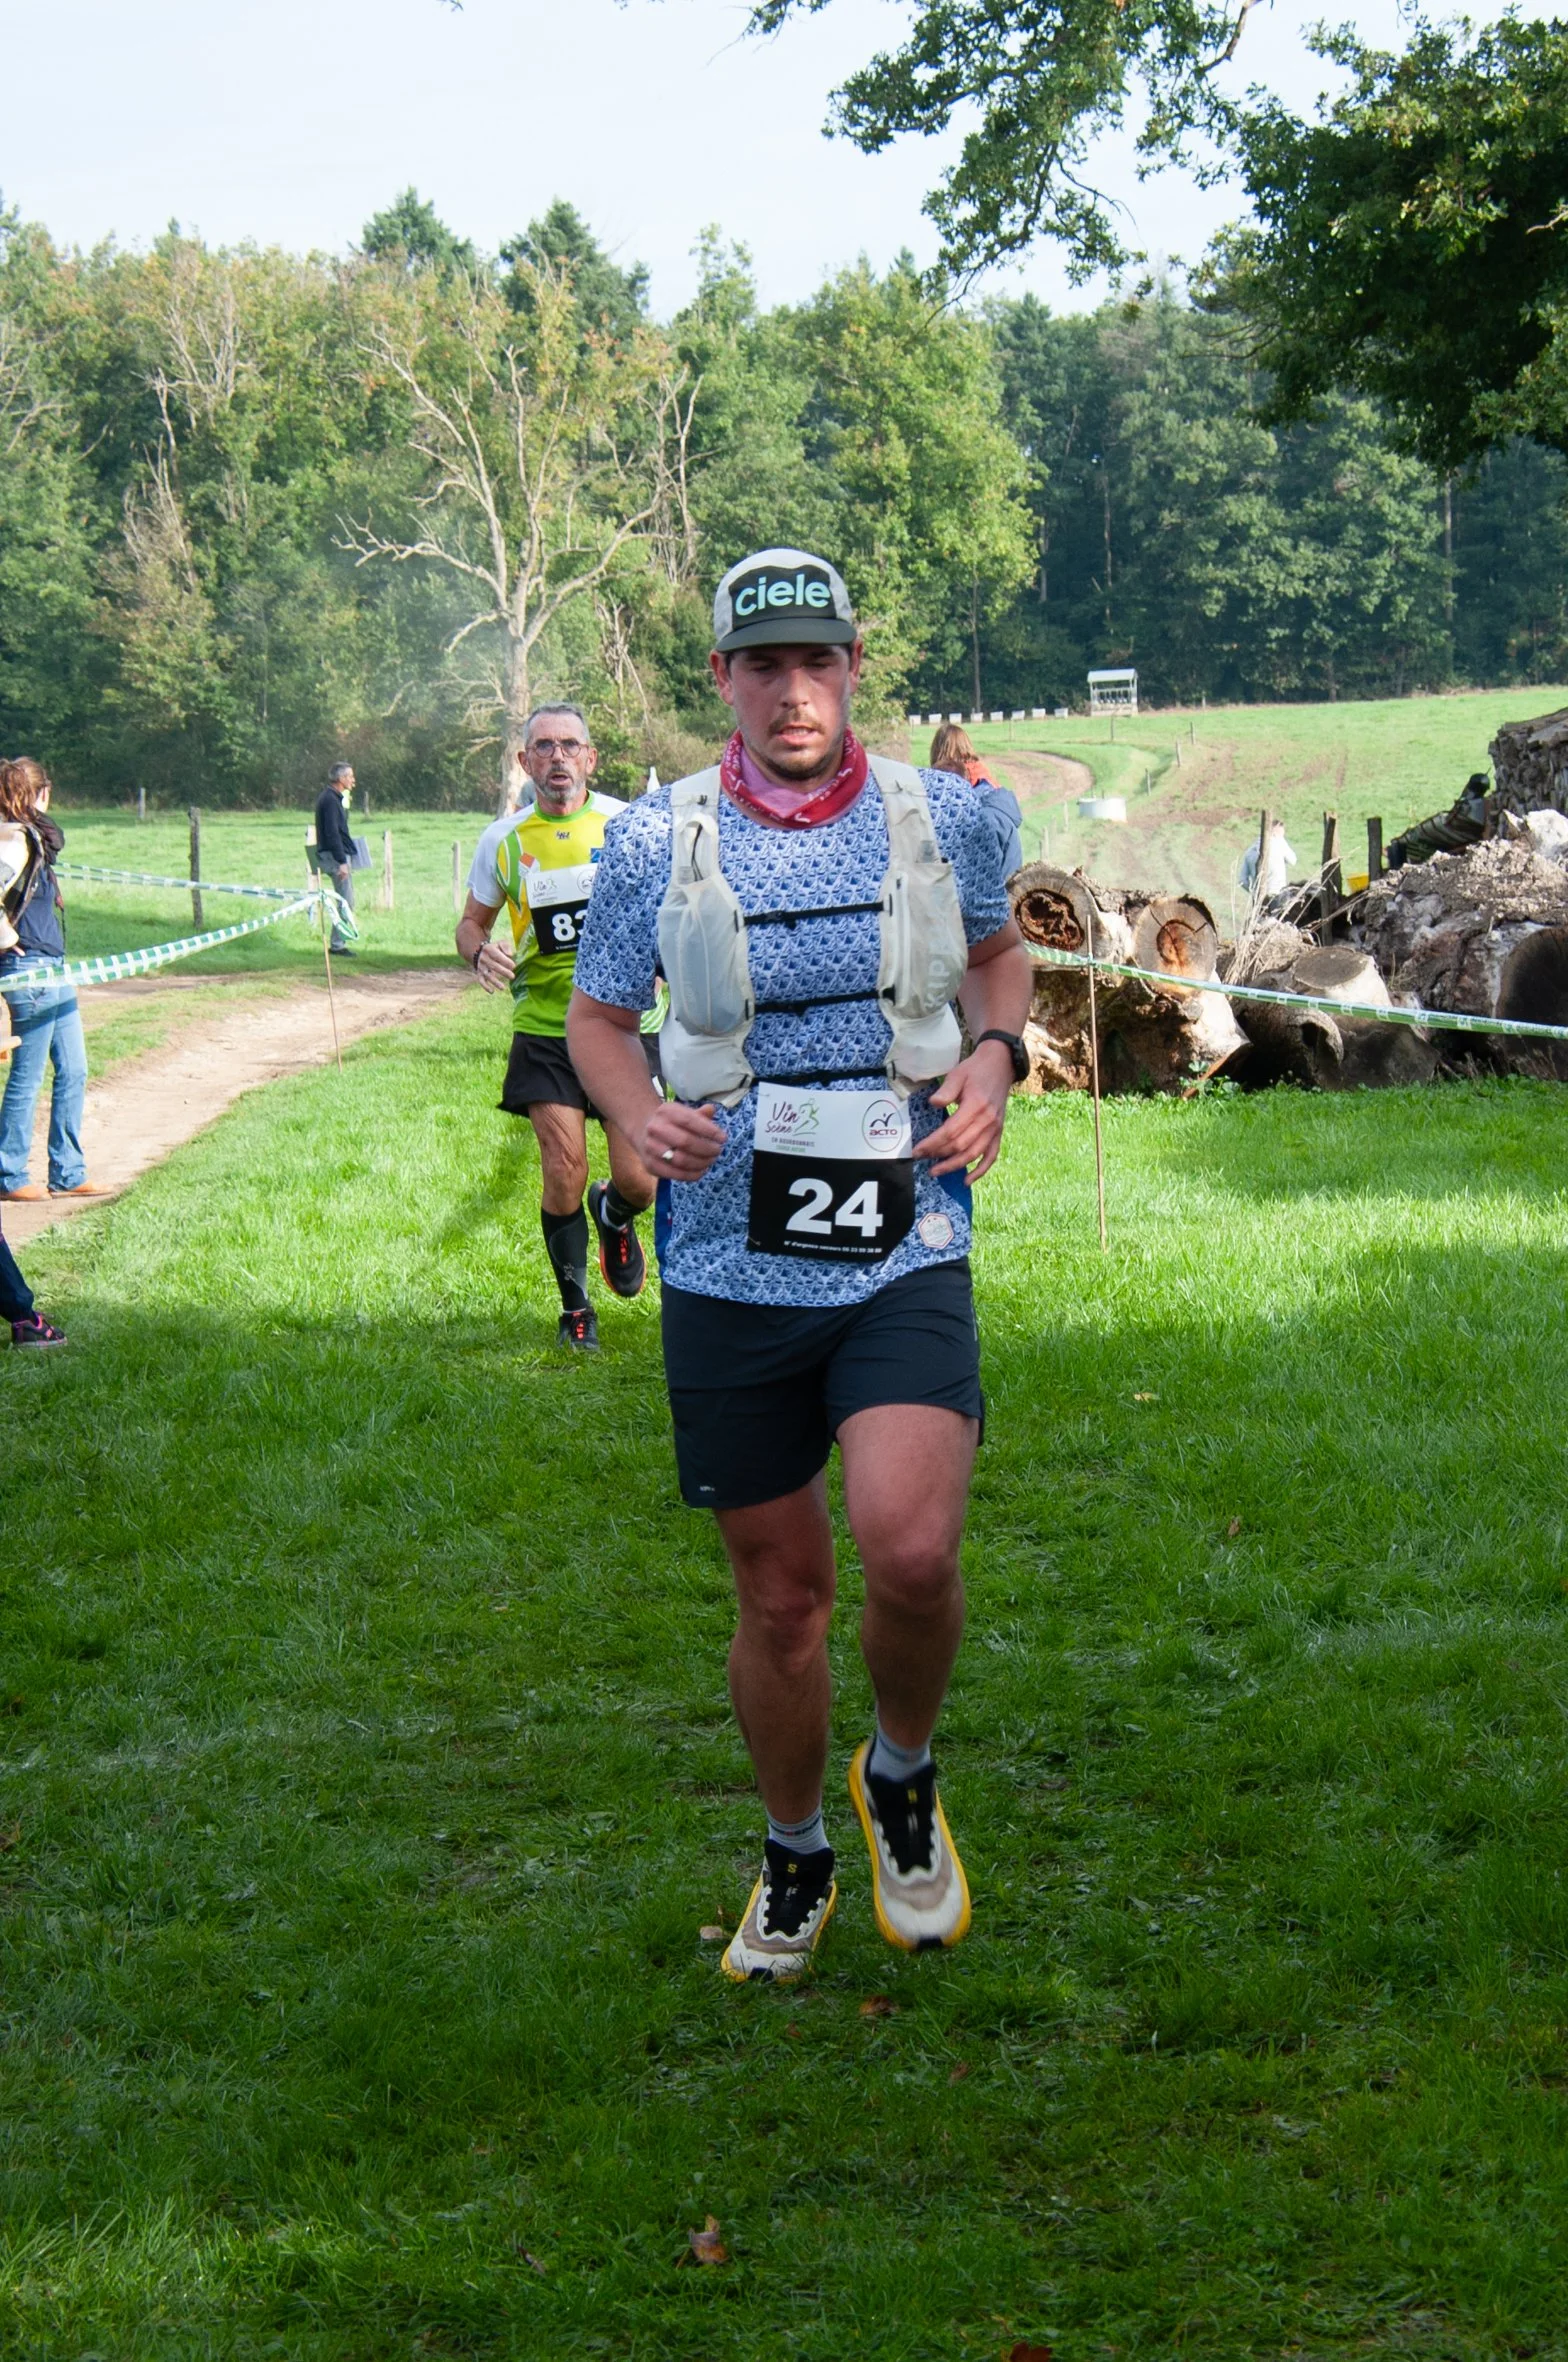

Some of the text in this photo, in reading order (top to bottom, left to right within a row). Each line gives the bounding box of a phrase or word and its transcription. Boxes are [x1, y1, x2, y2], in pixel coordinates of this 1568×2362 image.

[735, 574, 831, 616] ciele
[773, 1101, 800, 1123] Vin
[785, 1177, 884, 1237] 24
